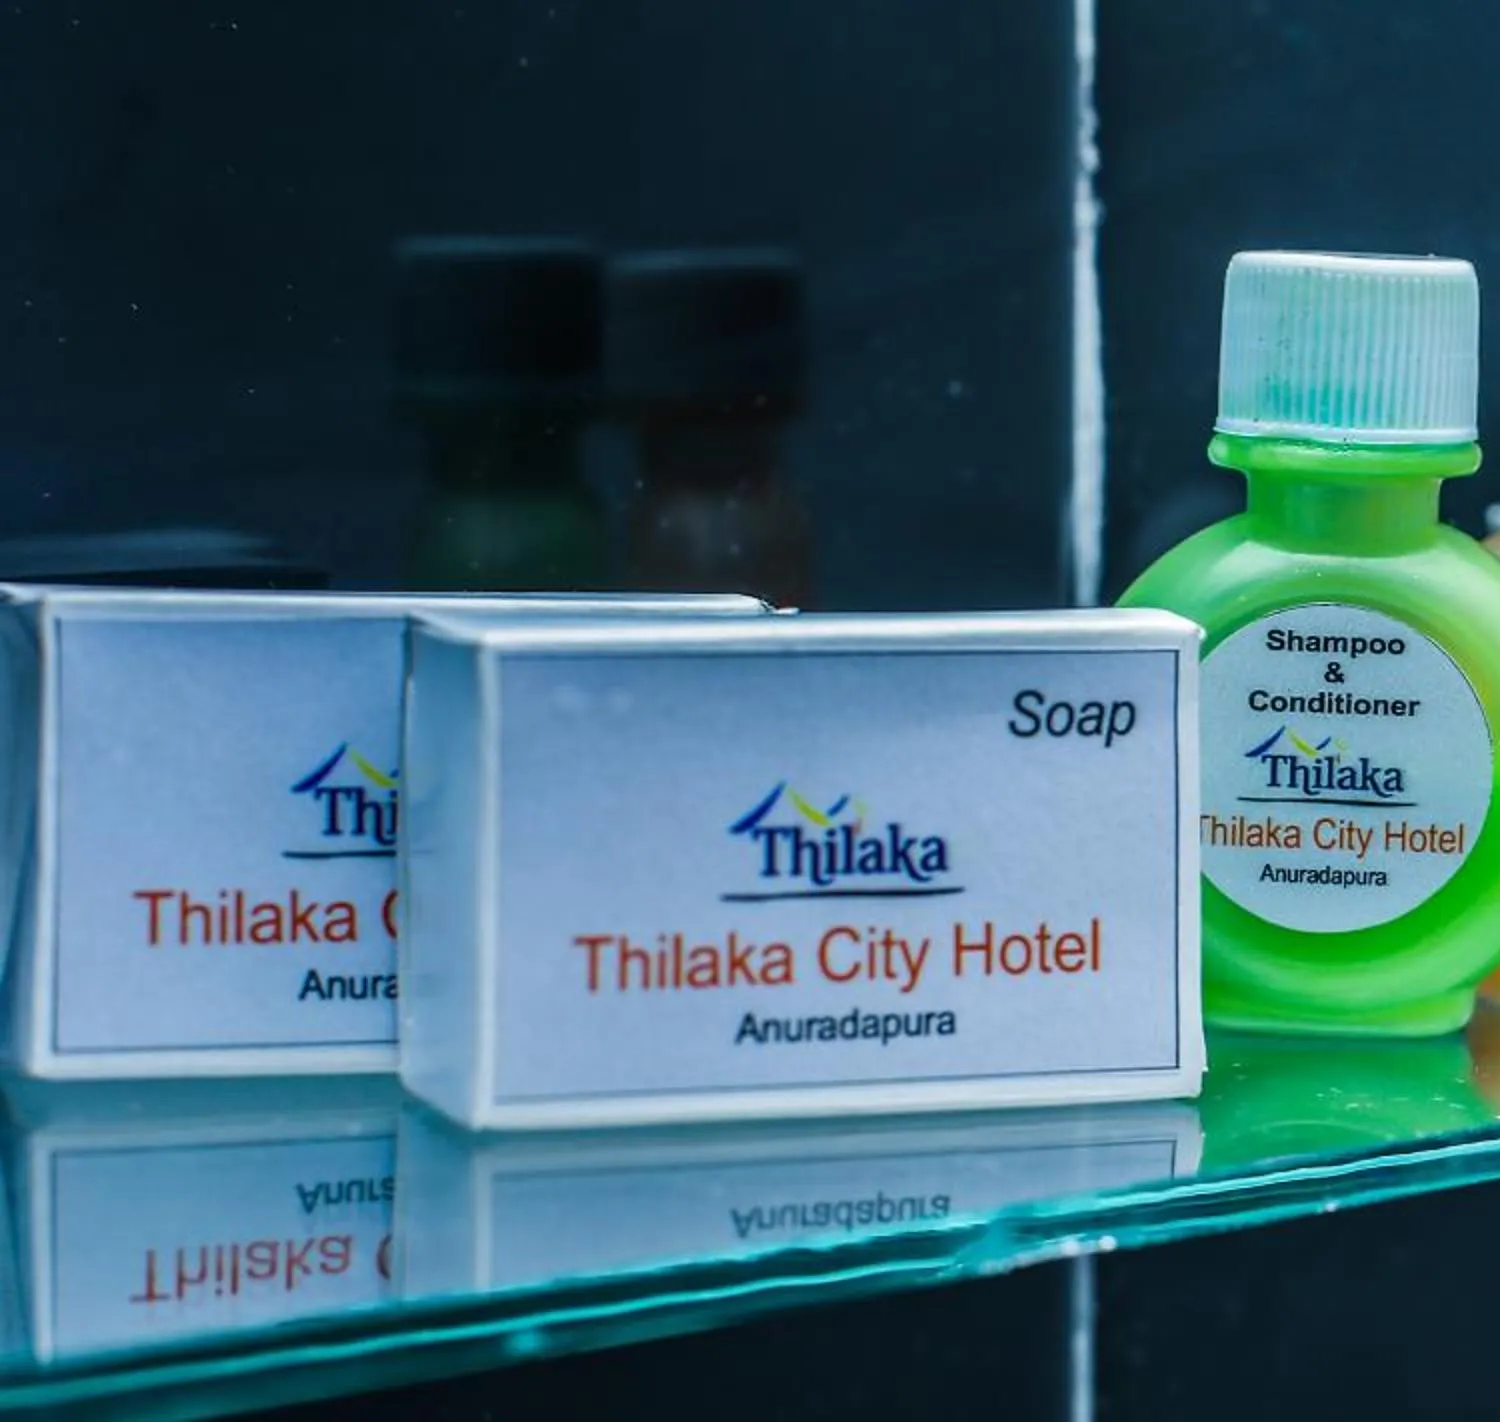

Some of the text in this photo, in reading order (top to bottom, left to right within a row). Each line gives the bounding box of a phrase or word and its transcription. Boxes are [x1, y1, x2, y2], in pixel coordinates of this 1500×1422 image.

[1266, 629, 1406, 659] Shampoo
[1324, 661, 1345, 684] &
[1008, 690, 1137, 746] Soap
[1248, 690, 1420, 717] Conditioner
[1261, 754, 1404, 798] Thilaka
[314, 786, 397, 846] Thi
[752, 823, 948, 886] Thilaka
[1313, 817, 1373, 859] City
[1385, 821, 1465, 854] Hotel
[1259, 863, 1387, 888] Anuradapura
[132, 890, 357, 947] Thilaka
[574, 917, 1102, 993] Thilaka City Hotel
[299, 968, 398, 1002] Anura
[734, 1008, 956, 1046] Anuradapura
